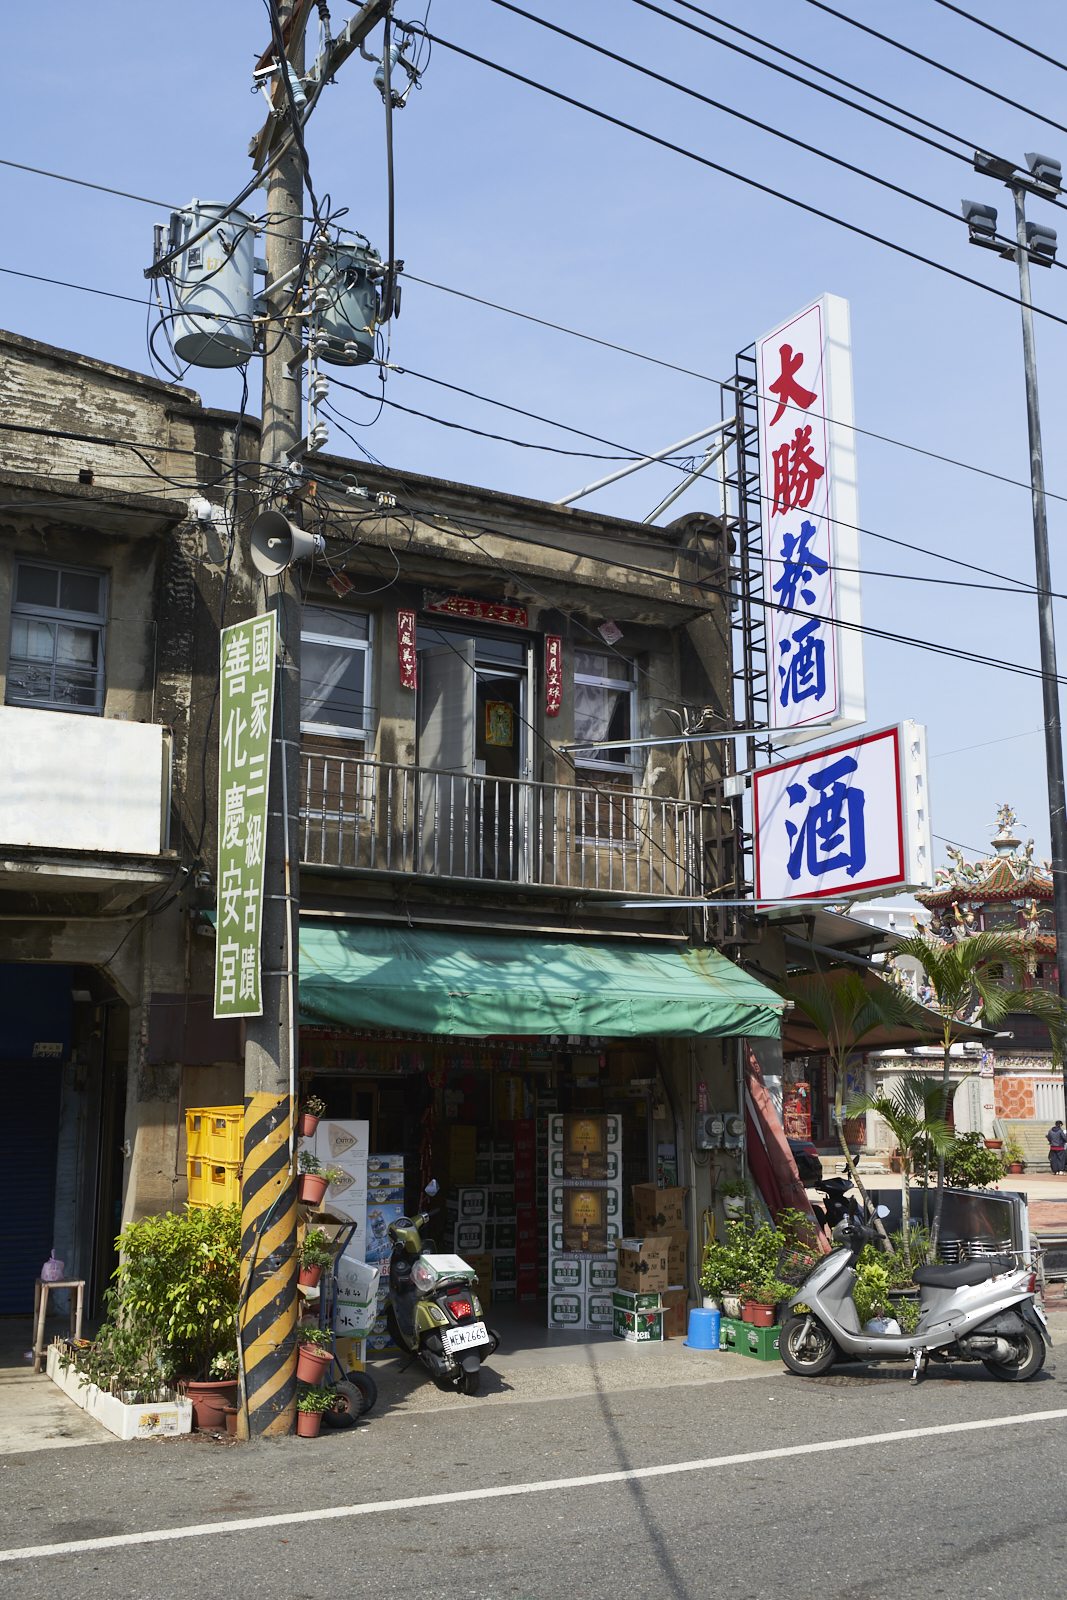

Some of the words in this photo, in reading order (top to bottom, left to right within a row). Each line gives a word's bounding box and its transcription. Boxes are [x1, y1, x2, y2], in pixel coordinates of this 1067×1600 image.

[769, 343, 829, 708] 大勝菸酒
[219, 631, 251, 1005] 善化慶安宮
[238, 622, 272, 1001] 國家三級古蹟
[785, 756, 866, 878] 酒
